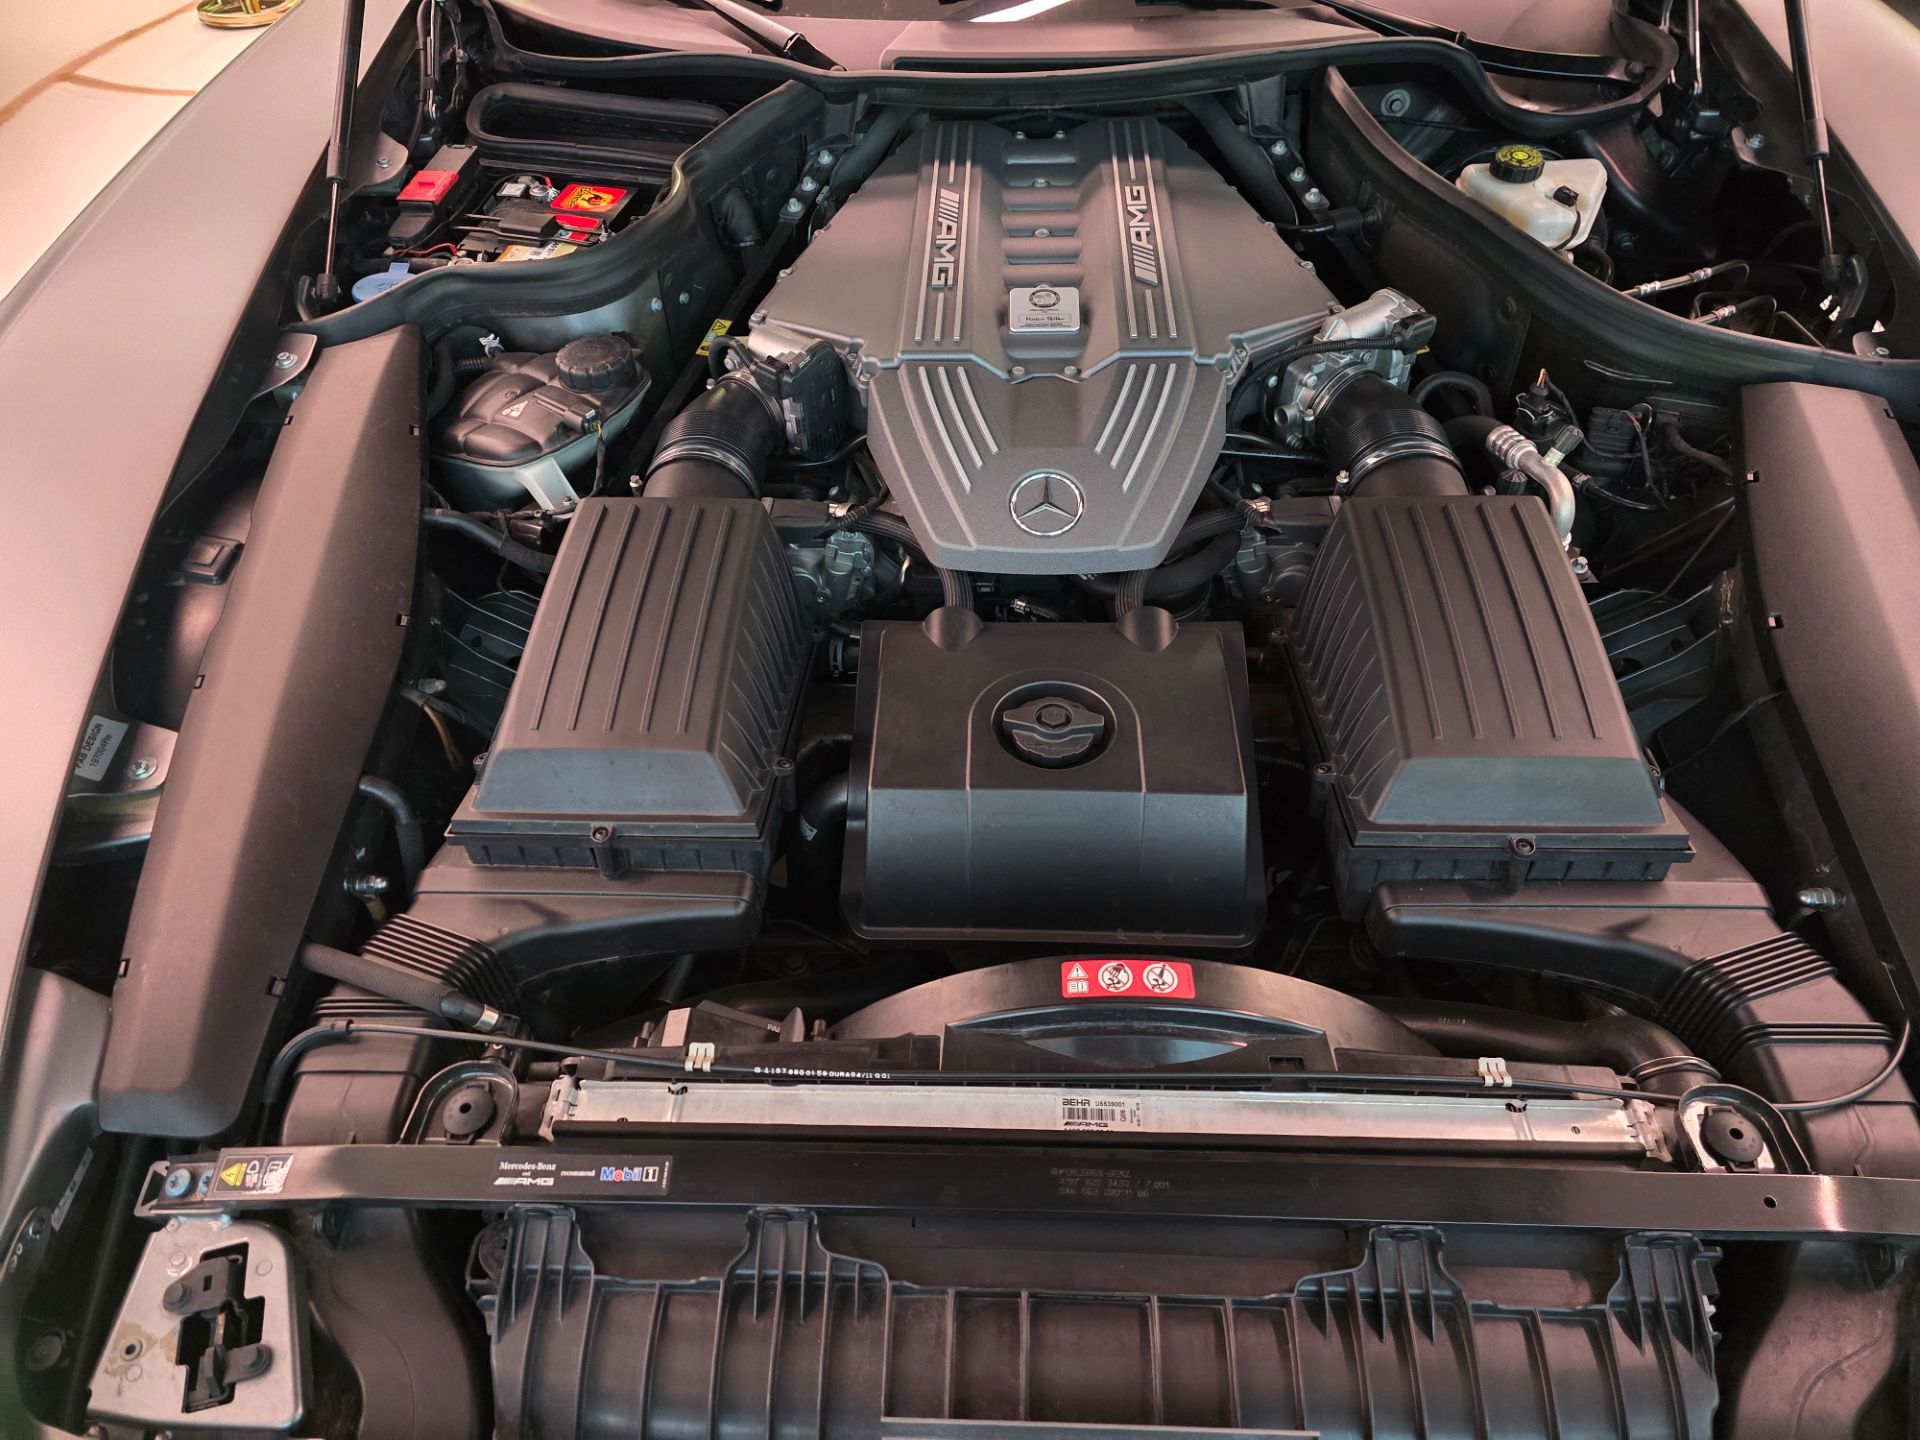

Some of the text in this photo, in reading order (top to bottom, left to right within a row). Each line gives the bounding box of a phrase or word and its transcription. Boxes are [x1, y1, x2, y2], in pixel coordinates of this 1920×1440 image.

[1124, 185, 1154, 251] AMG
[931, 219, 958, 289] AMG
[82, 722, 104, 752] DESIGN
[1062, 1098, 1091, 1107] BEHR
[499, 1161, 557, 1171] Mercedes-Benz
[600, 1166, 643, 1183] Mobil
[513, 1177, 555, 1186] AMG
